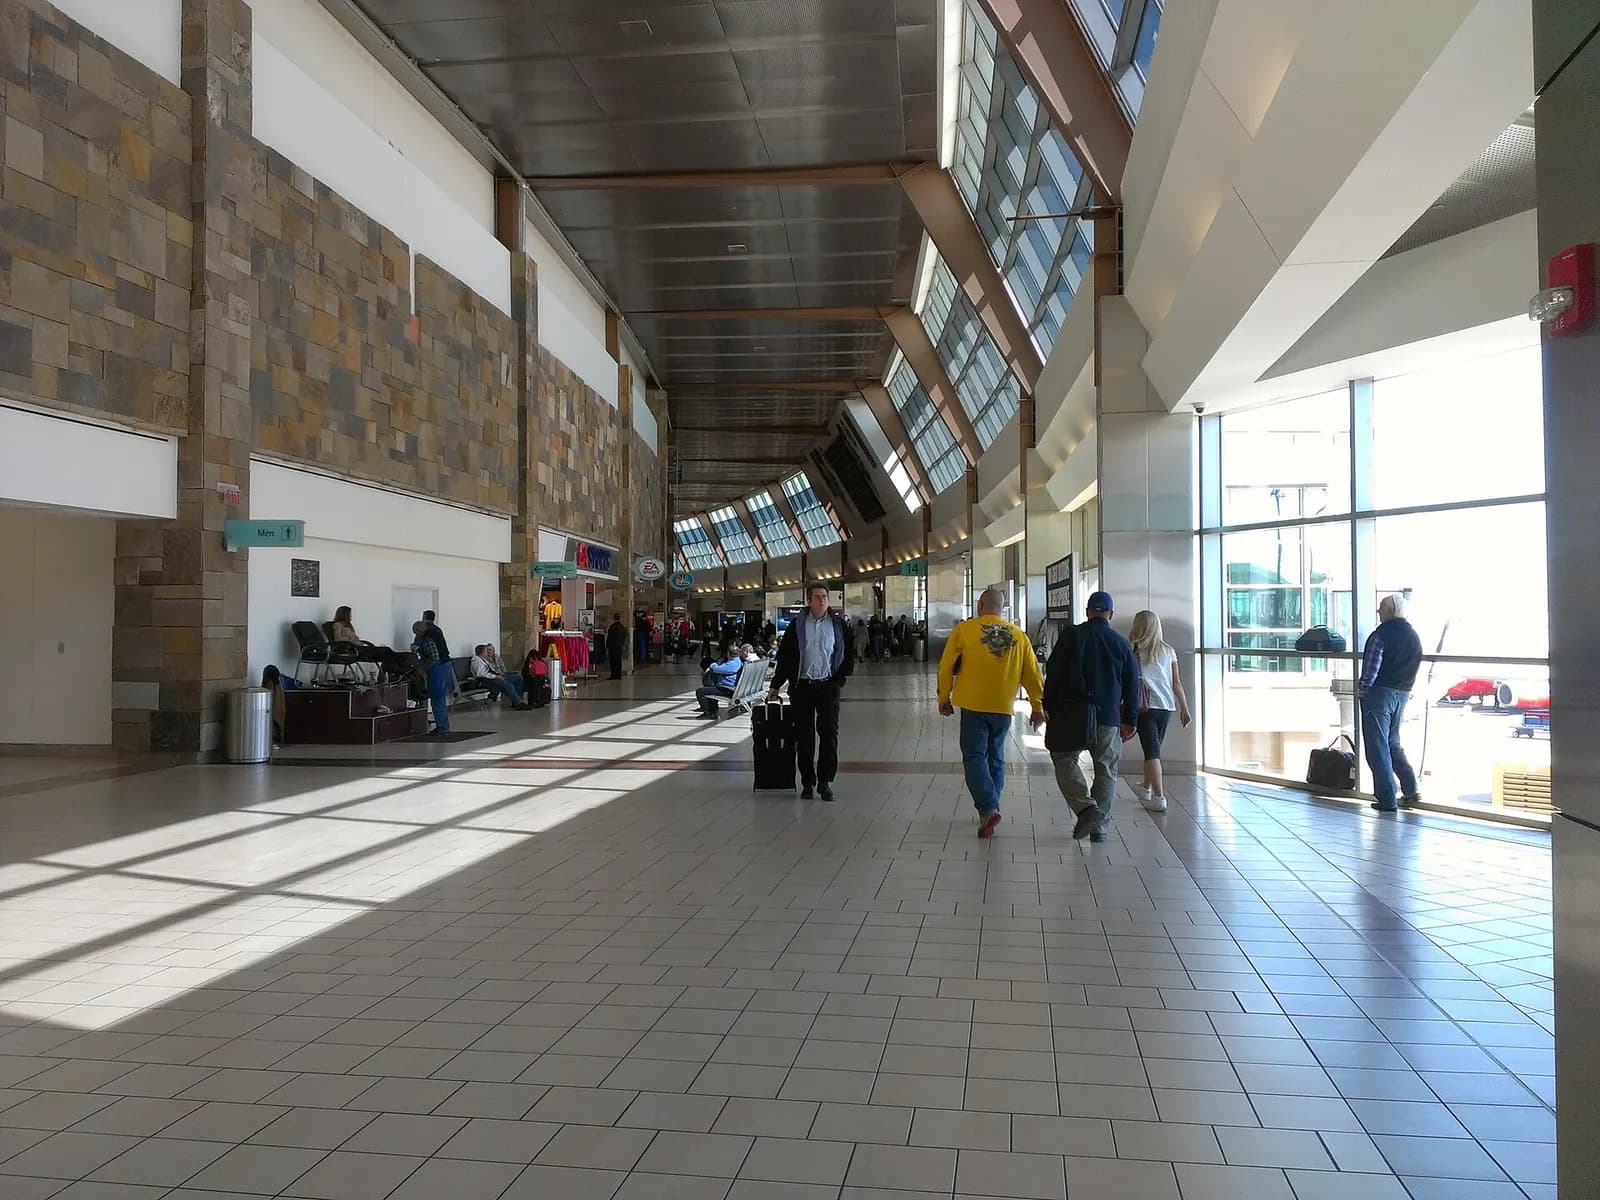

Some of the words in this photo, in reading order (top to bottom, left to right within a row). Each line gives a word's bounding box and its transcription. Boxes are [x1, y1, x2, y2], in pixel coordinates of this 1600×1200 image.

[257, 529, 275, 537] Men
[644, 562, 659, 570] EA
[907, 563, 920, 574] 14
